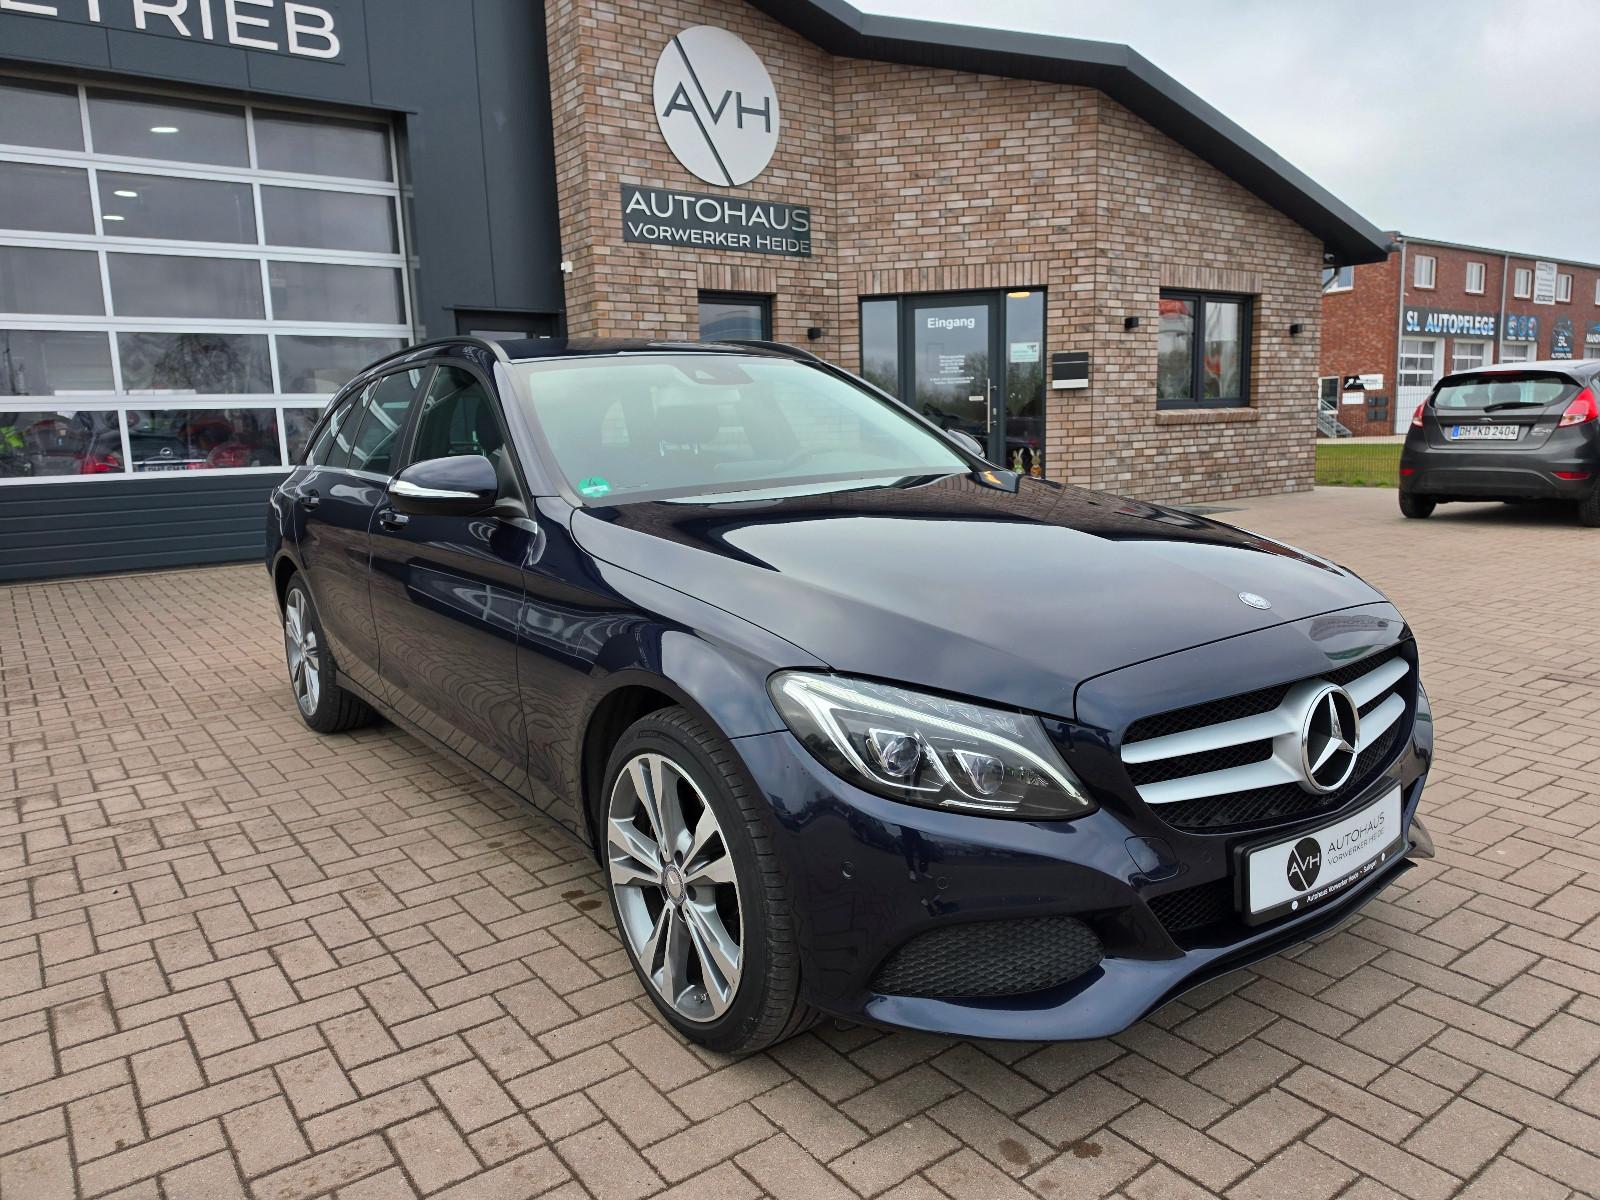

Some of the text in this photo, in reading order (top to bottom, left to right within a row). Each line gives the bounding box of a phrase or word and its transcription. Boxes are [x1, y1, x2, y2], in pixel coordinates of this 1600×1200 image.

[0, 0, 341, 59] RIEB
[625, 190, 809, 232] AUTOHAUS
[627, 221, 810, 253] VORWERKER HEIDE
[927, 317, 975, 330] Eingang
[1406, 310, 1495, 336] SL AUTOPFLEGE
[1327, 811, 1385, 855] AUTOHAUS
[1327, 840, 1368, 865] VORWERKER
